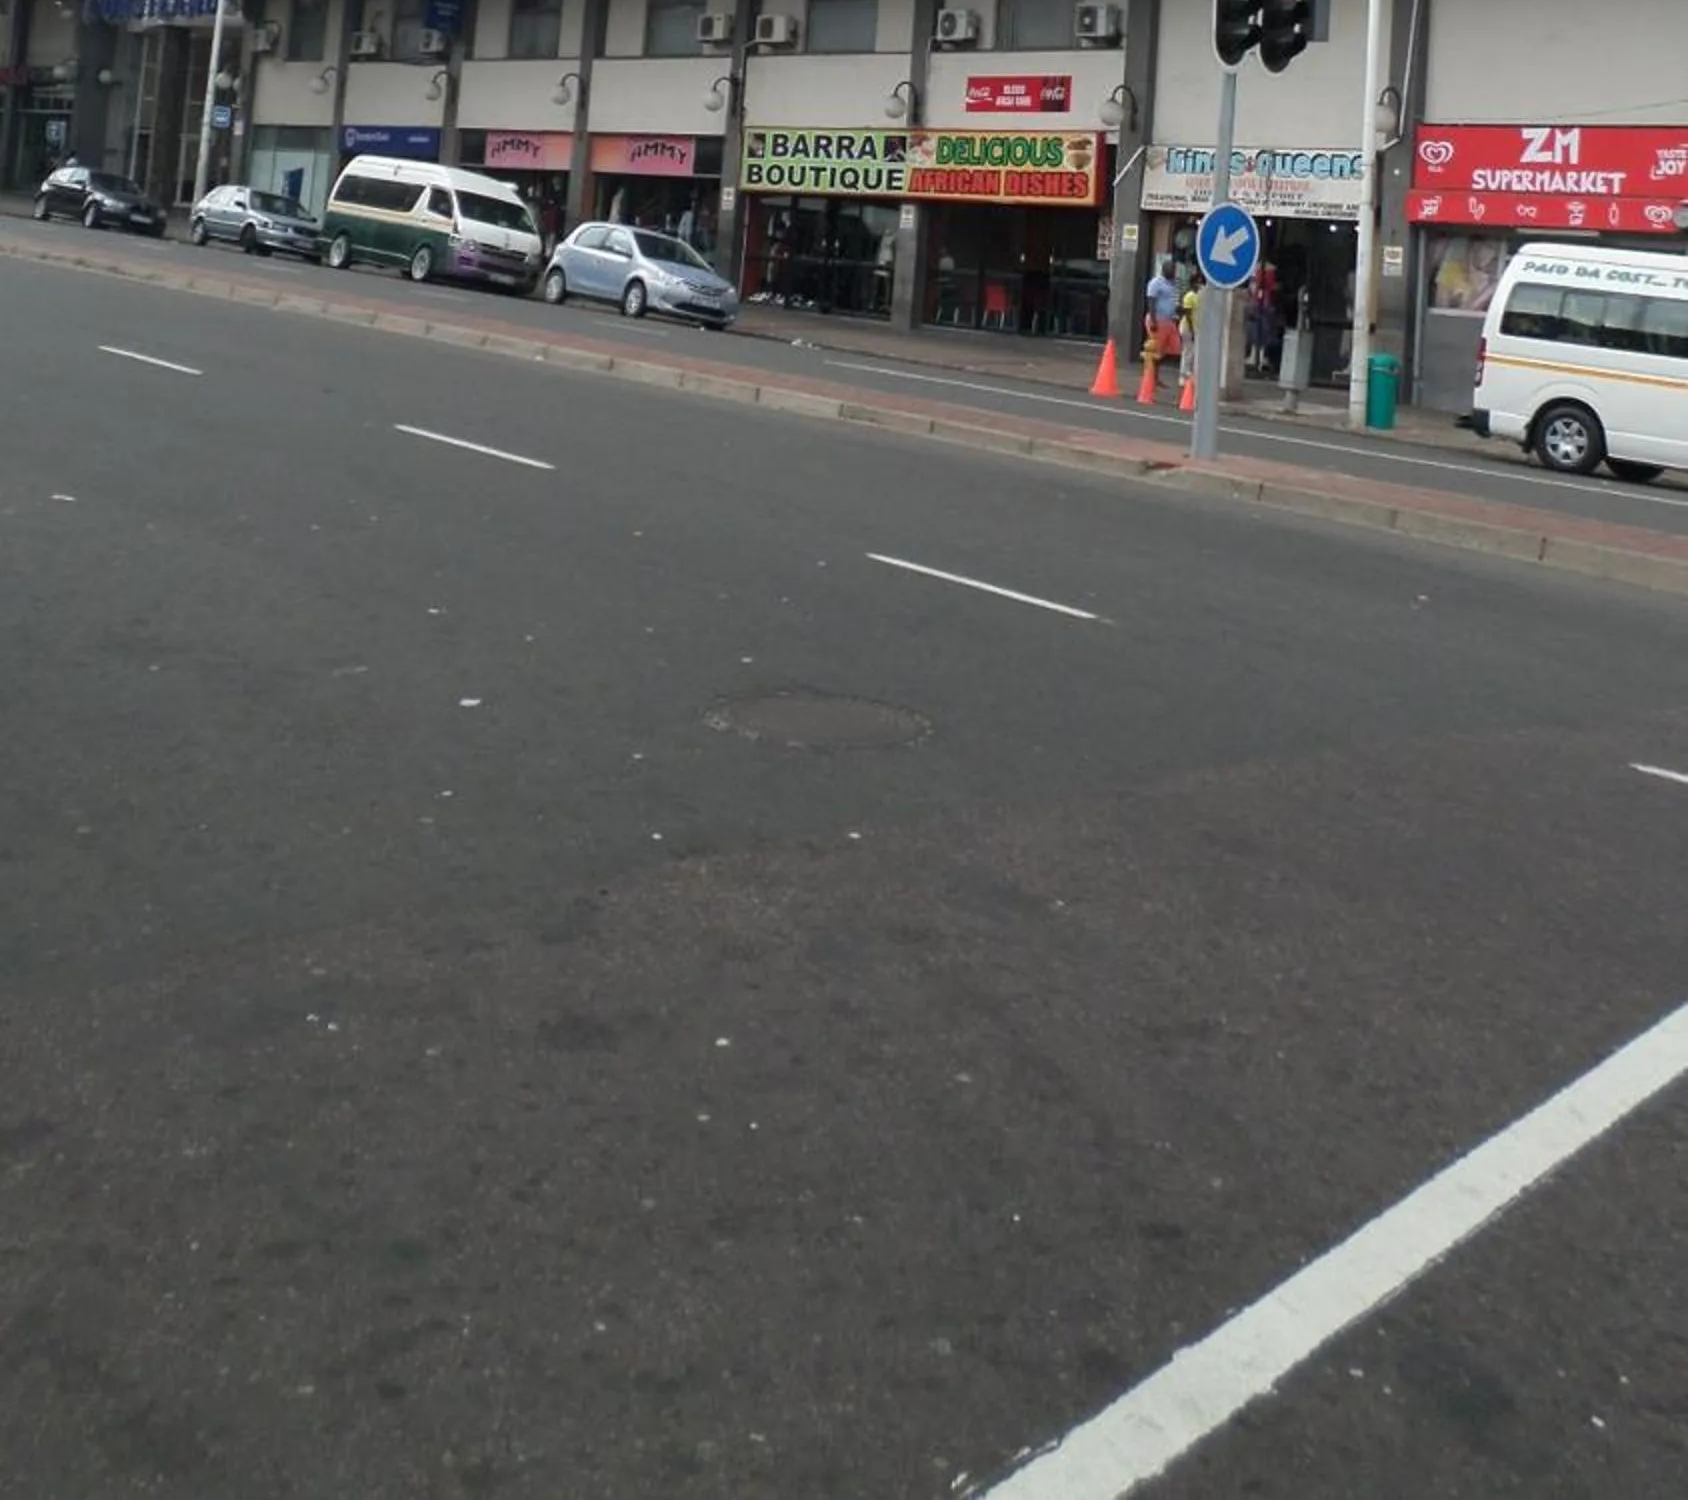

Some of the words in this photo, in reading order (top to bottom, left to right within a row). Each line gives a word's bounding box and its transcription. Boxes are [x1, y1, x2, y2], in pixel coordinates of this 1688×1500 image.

[490, 138, 541, 158] AMMY
[629, 141, 687, 165] AMMY
[771, 133, 878, 161] BARRA
[935, 135, 1065, 167] DELICIOUS
[1520, 127, 1581, 164] ZM
[746, 164, 904, 191] BOUTIQUE
[1655, 160, 1687, 176] JOY
[908, 167, 1000, 195] AFRICAN
[1003, 170, 1089, 198] DISHES
[1472, 169, 1626, 194] SUPERMARKET
[1522, 261, 1569, 275] PAID
